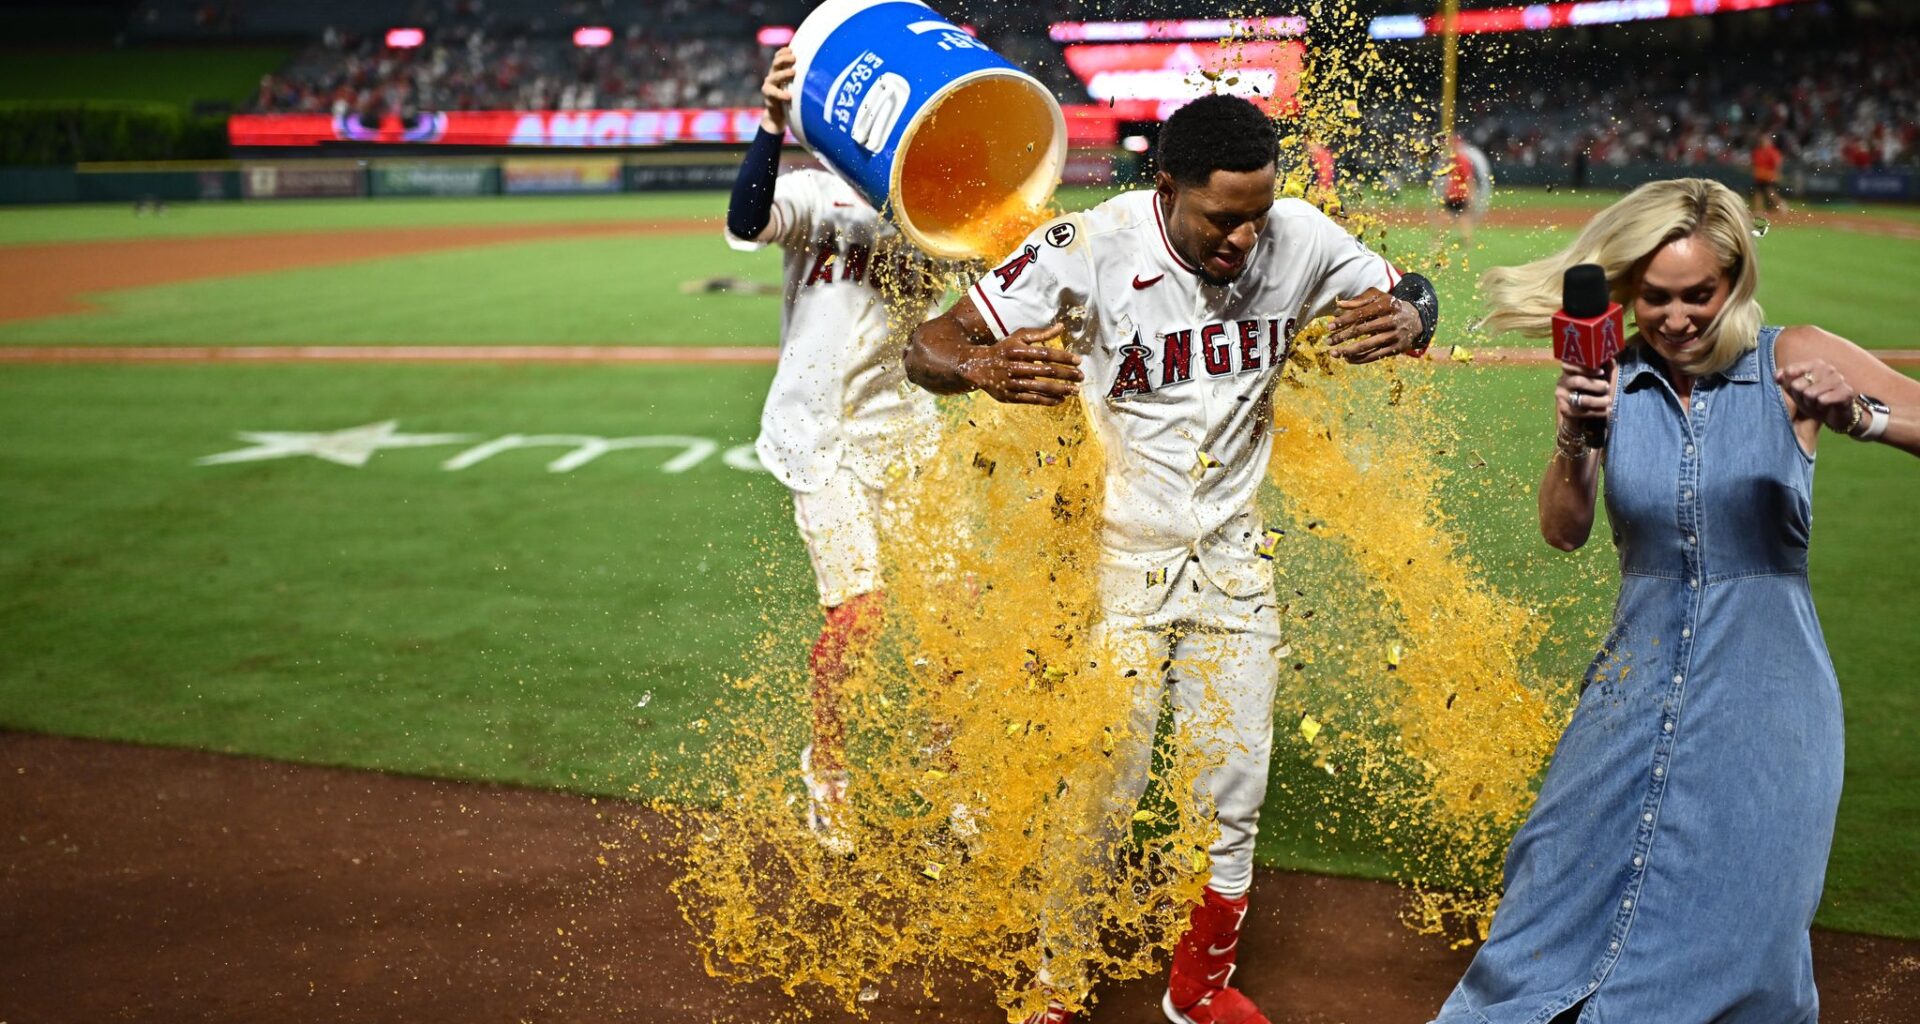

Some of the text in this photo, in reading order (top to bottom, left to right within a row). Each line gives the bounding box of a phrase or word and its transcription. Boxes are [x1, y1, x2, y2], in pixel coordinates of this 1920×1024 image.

[834, 51, 877, 121] SWEAT
[838, 56, 884, 133] POCARI
[1051, 224, 1071, 245] GA
[993, 244, 1042, 293] A
[1561, 322, 1586, 366] A
[1600, 317, 1620, 363] A
